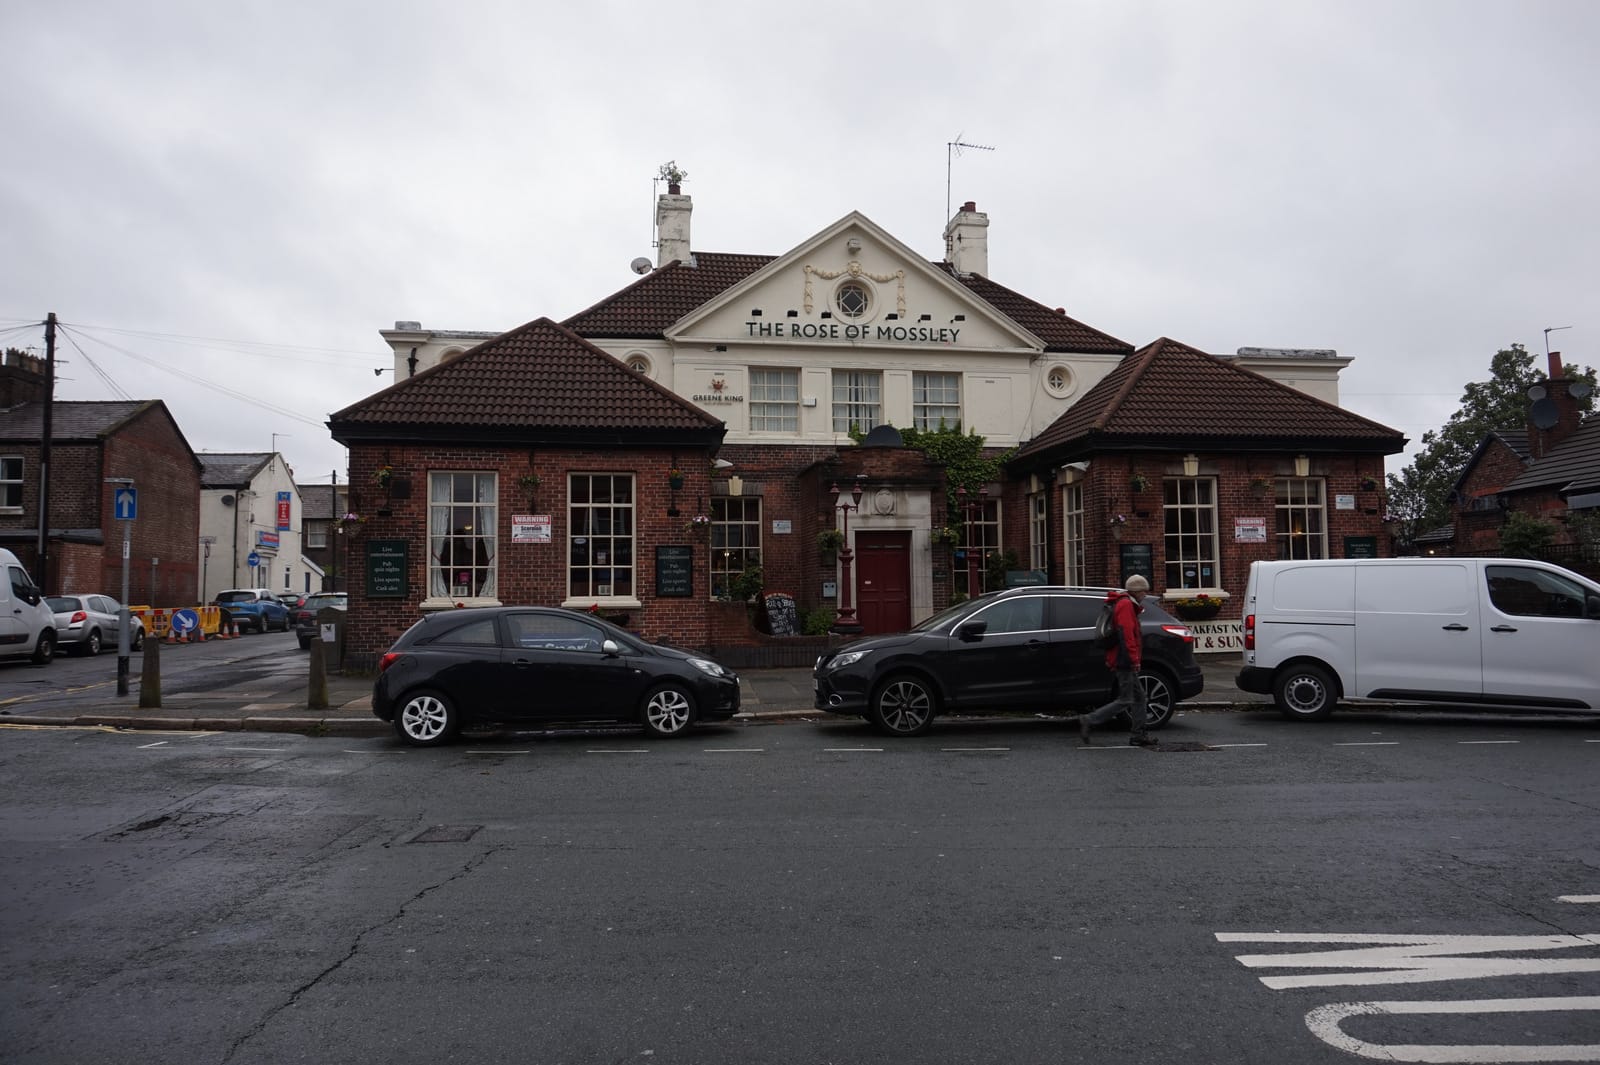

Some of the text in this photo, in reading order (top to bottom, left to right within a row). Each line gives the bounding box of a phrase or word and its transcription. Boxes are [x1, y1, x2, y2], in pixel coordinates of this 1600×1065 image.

[746, 322, 960, 343] THE ROSE OF MOSSLEY
[693, 394, 722, 402] GREENE
[1205, 635, 1215, 649] &
